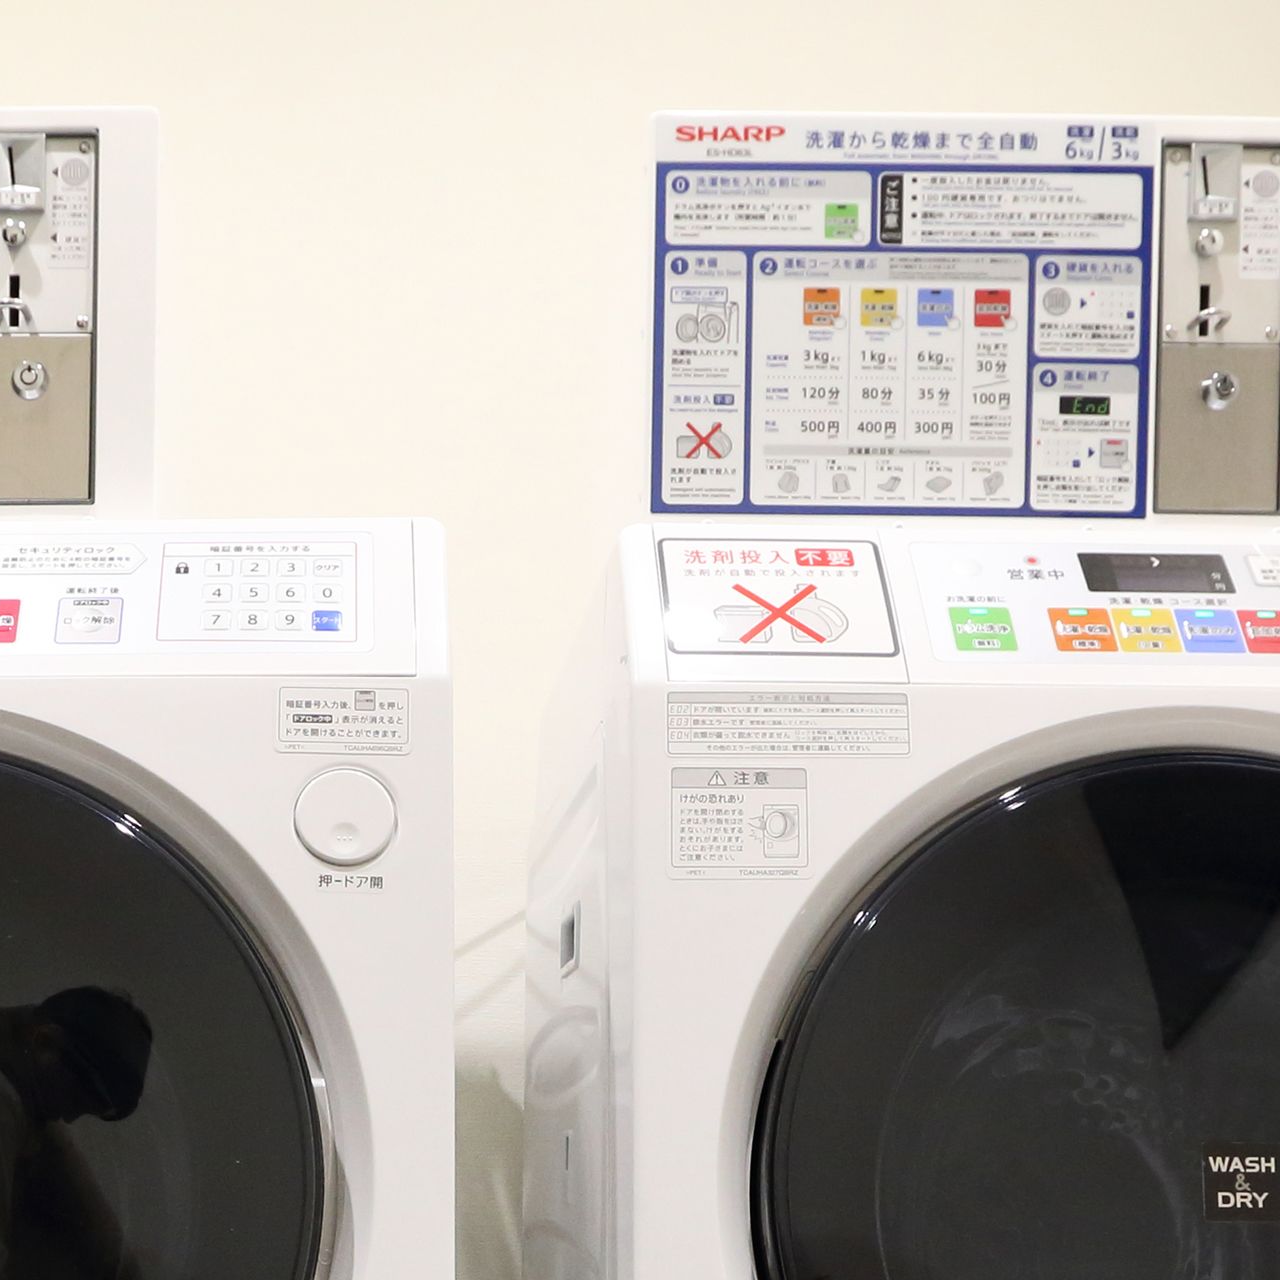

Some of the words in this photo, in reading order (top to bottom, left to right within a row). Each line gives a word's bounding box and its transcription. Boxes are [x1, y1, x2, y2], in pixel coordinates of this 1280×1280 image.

[674, 124, 786, 142] SHARP
[805, 129, 1039, 152] 洗濯から乾燥まで全自動
[1072, 396, 1109, 414] End
[209, 546, 311, 554] 暗証番号を入力する
[683, 549, 790, 566] 洗剤投入
[798, 550, 851, 566] 不要
[215, 563, 222, 573] 1
[249, 561, 260, 573] 2
[285, 561, 297, 573] 3
[683, 569, 860, 578] 洗剤が自動で投入されます
[1007, 568, 1065, 581] 営業中
[211, 588, 223, 598] 4
[248, 587, 259, 599] 5
[285, 587, 296, 599] 6
[321, 587, 333, 599] 0
[211, 615, 221, 625] 7
[247, 613, 259, 626] 8
[284, 613, 295, 626] 9
[312, 617, 341, 625] スタート
[285, 701, 353, 710] 暗証番号入力後、
[378, 702, 405, 711] を押し
[284, 729, 403, 739] ドアを開けることができます。
[733, 770, 770, 786] 注意
[679, 794, 745, 804] けがの恐れあり
[679, 809, 745, 817] ドアを開け閉めする
[679, 854, 736, 862] ご注意ください。
[1208, 1156, 1276, 1173] WASH
[1234, 1173, 1252, 1192] &
[1217, 1191, 1270, 1209] DRY
